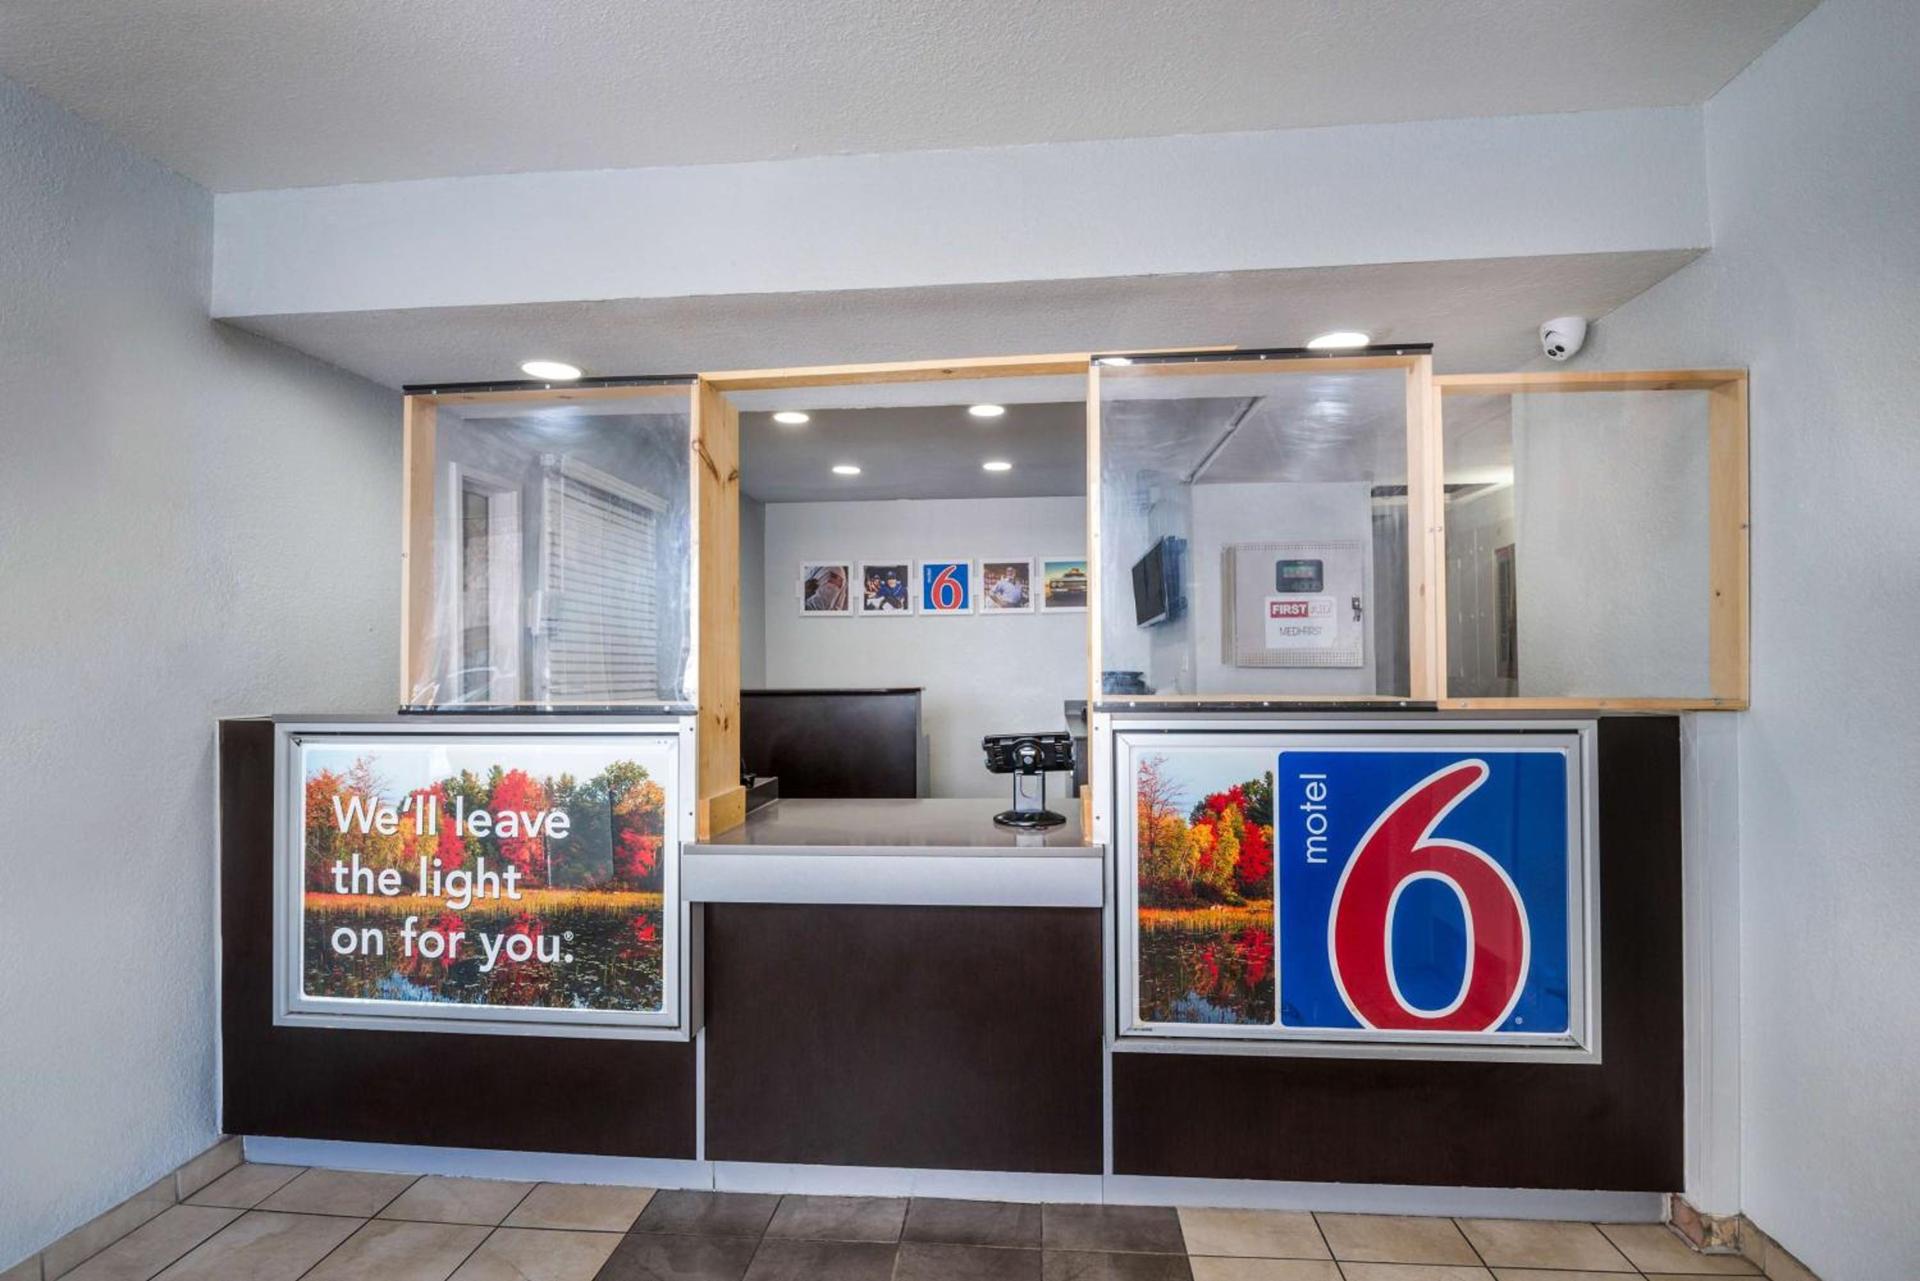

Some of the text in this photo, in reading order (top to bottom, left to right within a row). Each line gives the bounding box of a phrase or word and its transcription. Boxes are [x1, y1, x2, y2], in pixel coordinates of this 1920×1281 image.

[931, 565, 964, 610] 6
[1272, 603, 1307, 615] FIRST
[332, 794, 571, 839] We’ll leave
[331, 852, 523, 911] the light
[1299, 758, 1532, 1033] motel 6
[331, 925, 384, 957] on
[400, 915, 466, 960] for
